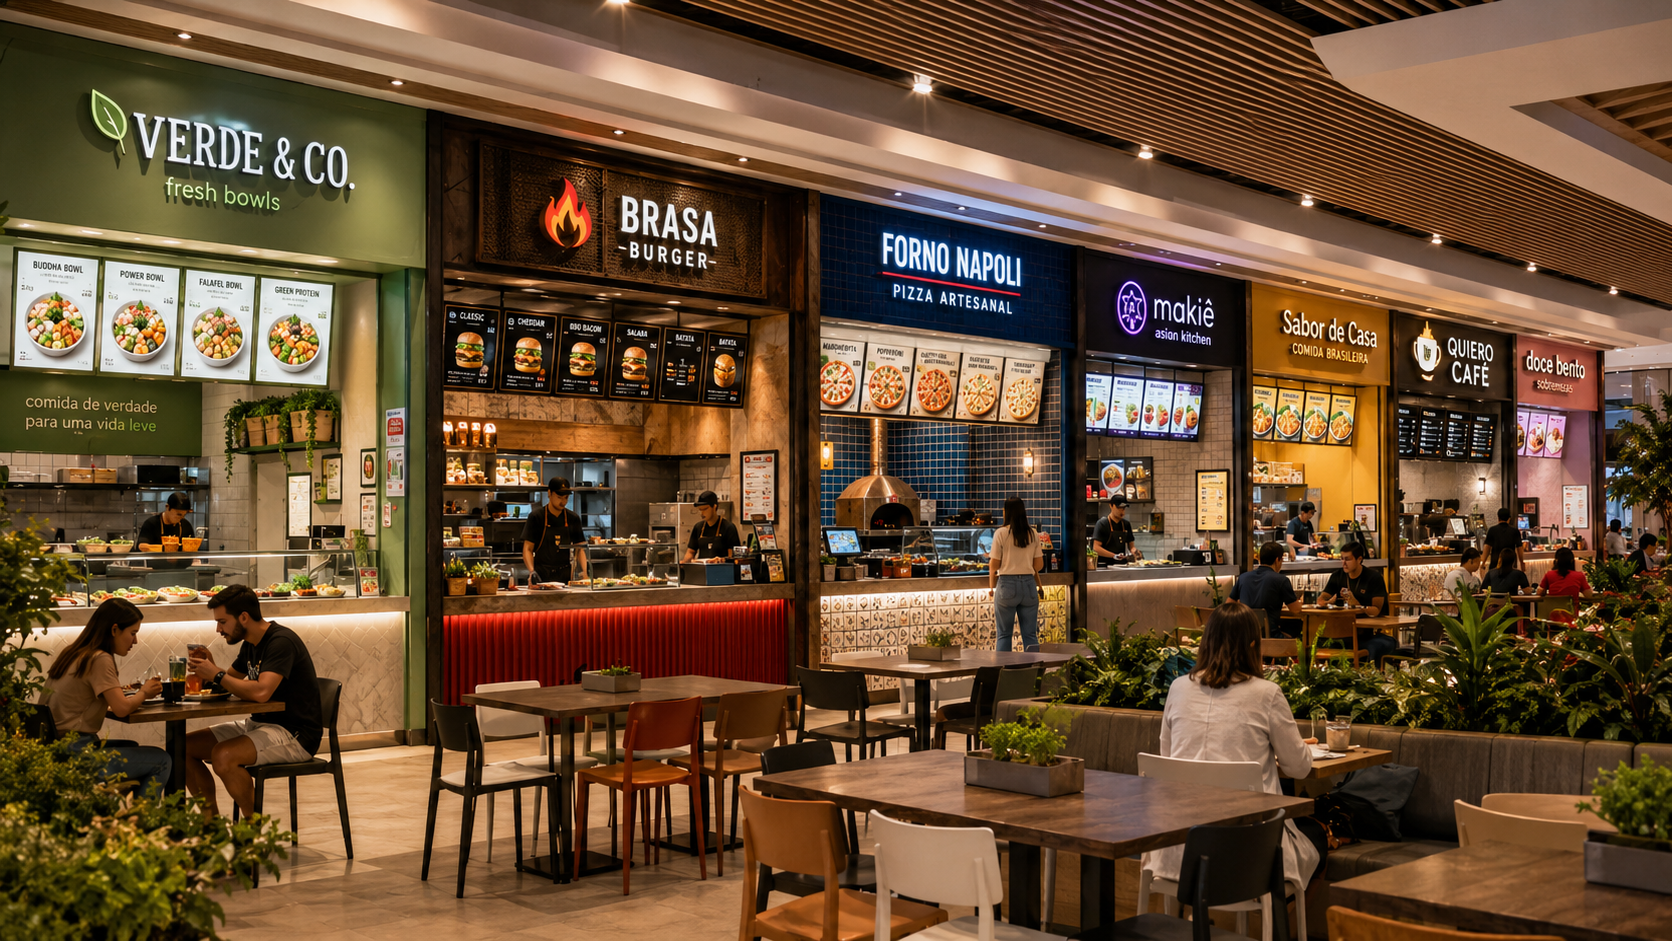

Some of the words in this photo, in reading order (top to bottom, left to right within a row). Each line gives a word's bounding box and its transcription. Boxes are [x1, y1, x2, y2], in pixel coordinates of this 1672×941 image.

[132, 112, 263, 176] VERDE
[273, 137, 295, 181] &
[304, 140, 356, 191] CO.
[166, 176, 217, 202] fresh
[224, 184, 280, 211] bowls
[621, 195, 718, 247] BRASA
[33, 261, 62, 272] BUDDHA
[64, 264, 83, 274] BOWL
[630, 240, 707, 270] BURGER
[883, 232, 949, 275] FORNO
[957, 246, 1021, 287] NAPOLI
[120, 270, 144, 280] POWER
[146, 274, 164, 283] BOWL
[199, 278, 224, 289] FALAFEL
[226, 281, 243, 290] BOWL
[274, 286, 294, 295] GREEN
[894, 284, 933, 303] PIZZA
[940, 291, 1012, 315] ARTESANAL
[1154, 294, 1214, 328] makiê
[1181, 330, 1211, 346] kitchen
[1283, 309, 1324, 340] Sabor
[1328, 319, 1344, 341] de
[1348, 321, 1377, 348] Casa
[1292, 343, 1323, 358] COMIDA
[1326, 347, 1368, 364] BRASILEIRA
[1448, 337, 1494, 362] QUIERO
[1452, 361, 1490, 387] CAFÉ
[1527, 350, 1553, 374] doce
[1556, 355, 1586, 379] bento
[26, 396, 78, 410] comida
[83, 397, 100, 411] de
[104, 400, 157, 413] verdade
[26, 417, 58, 430] para
[63, 419, 92, 430] uma
[97, 418, 125, 431] vida
[129, 418, 157, 432] leve
